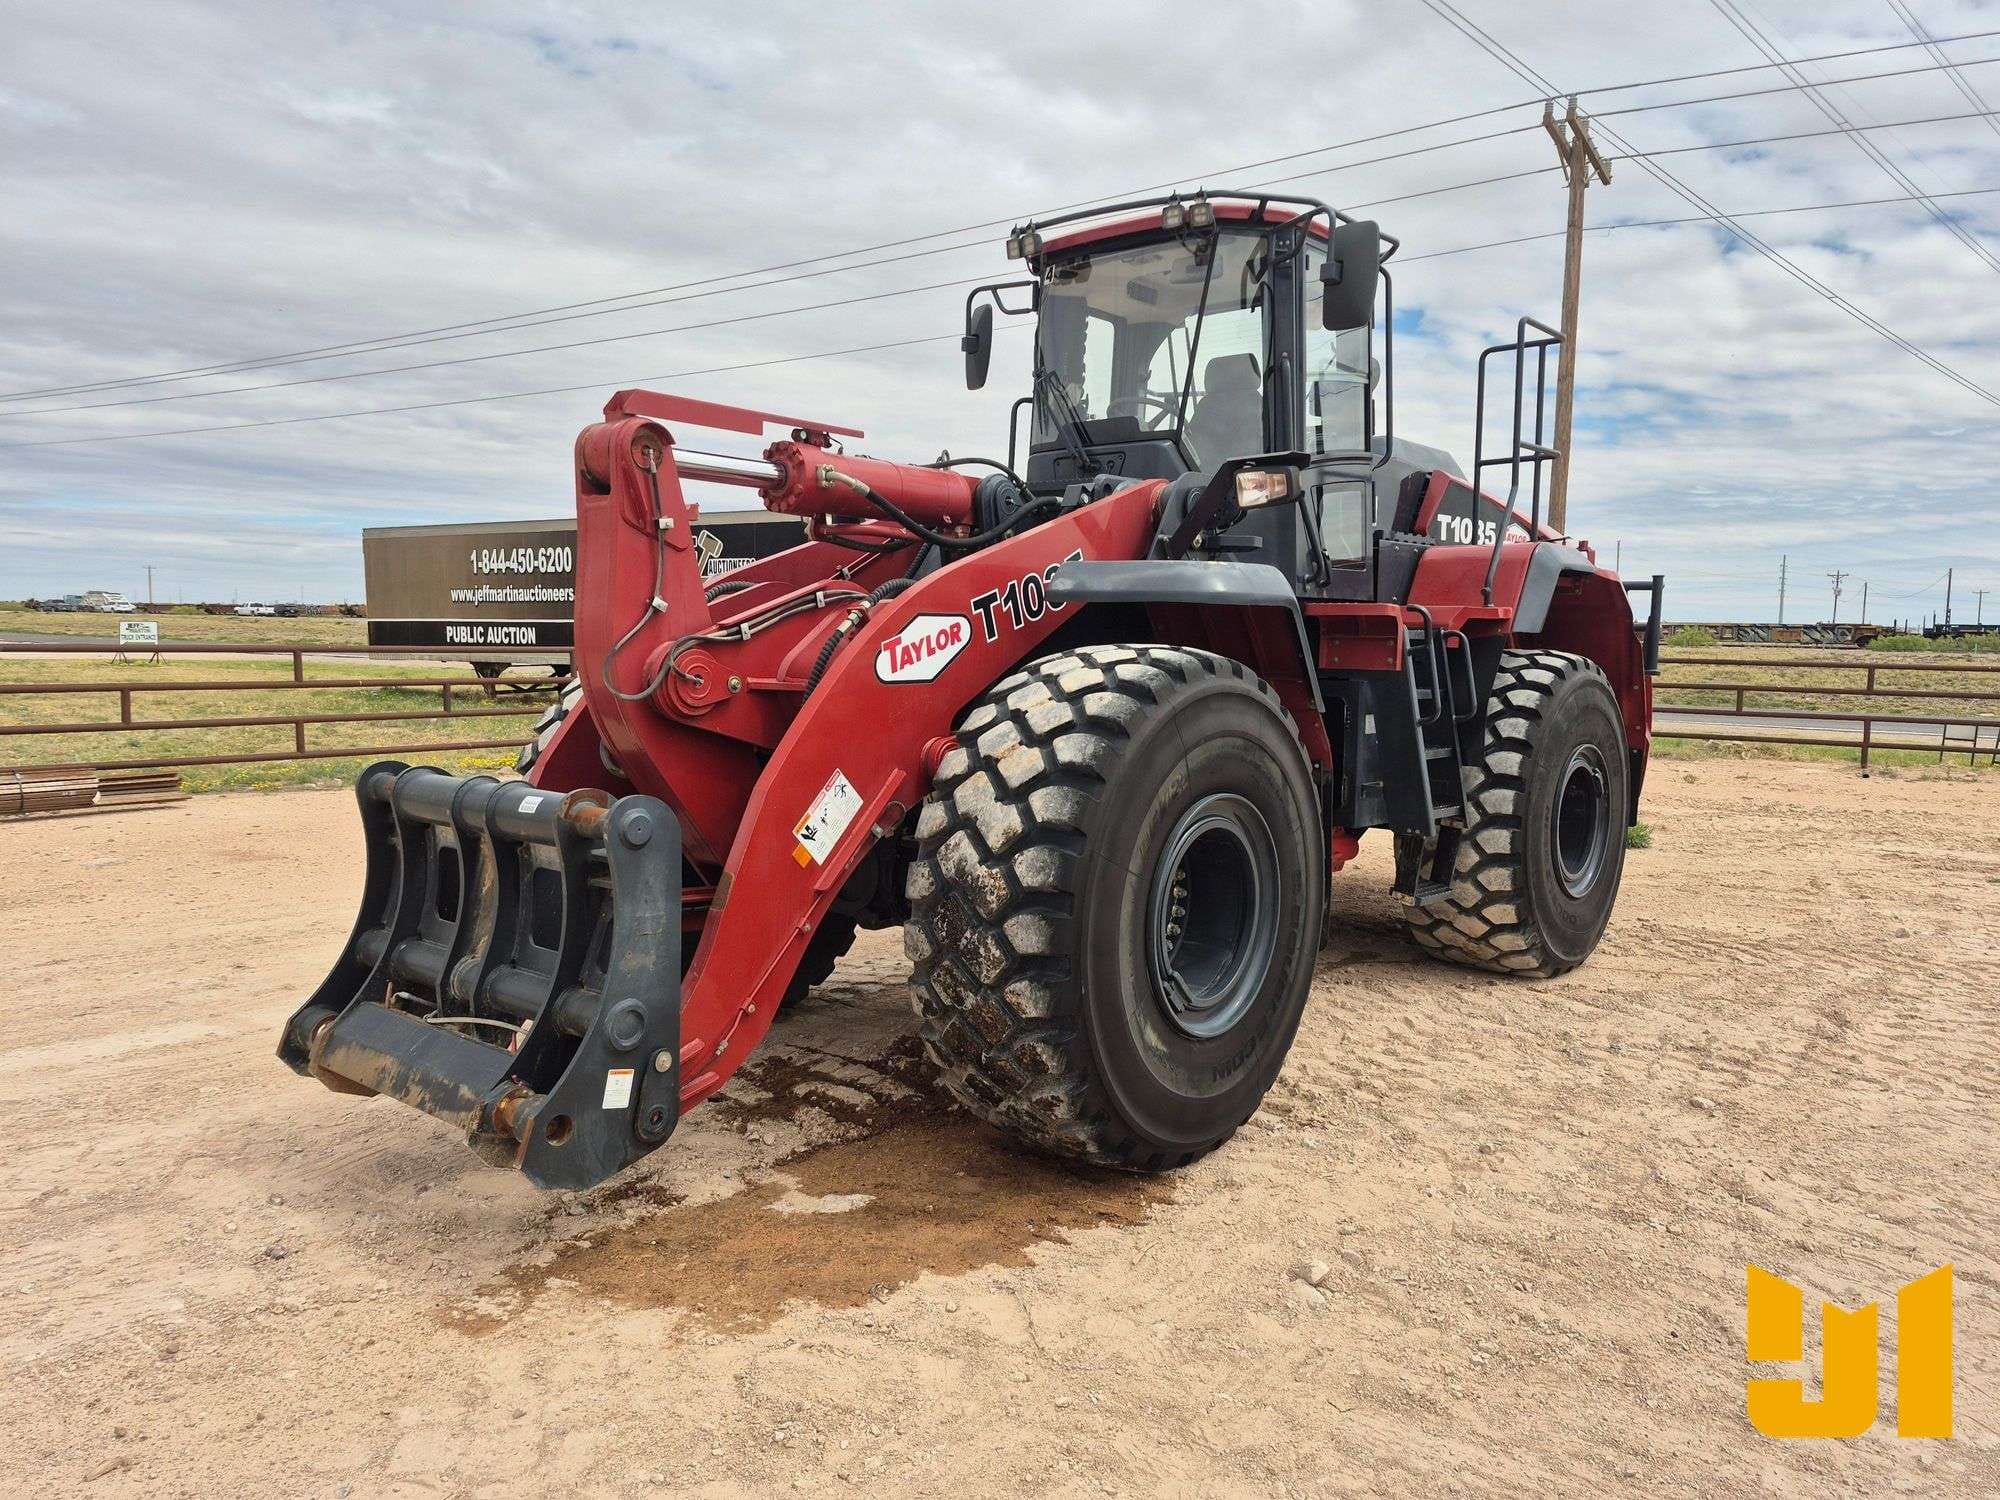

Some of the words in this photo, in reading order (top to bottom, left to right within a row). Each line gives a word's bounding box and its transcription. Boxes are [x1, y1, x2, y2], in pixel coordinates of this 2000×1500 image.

[470, 546, 573, 574] 1-844-450-6200
[707, 558, 756, 575] AUCTIONE
[450, 585, 575, 606] www.jeffmartinauctioneers
[971, 548, 1084, 643] T10
[446, 625, 485, 643] PUBLIC
[487, 626, 537, 645] AUCTION
[882, 621, 962, 674] TAYLOR
